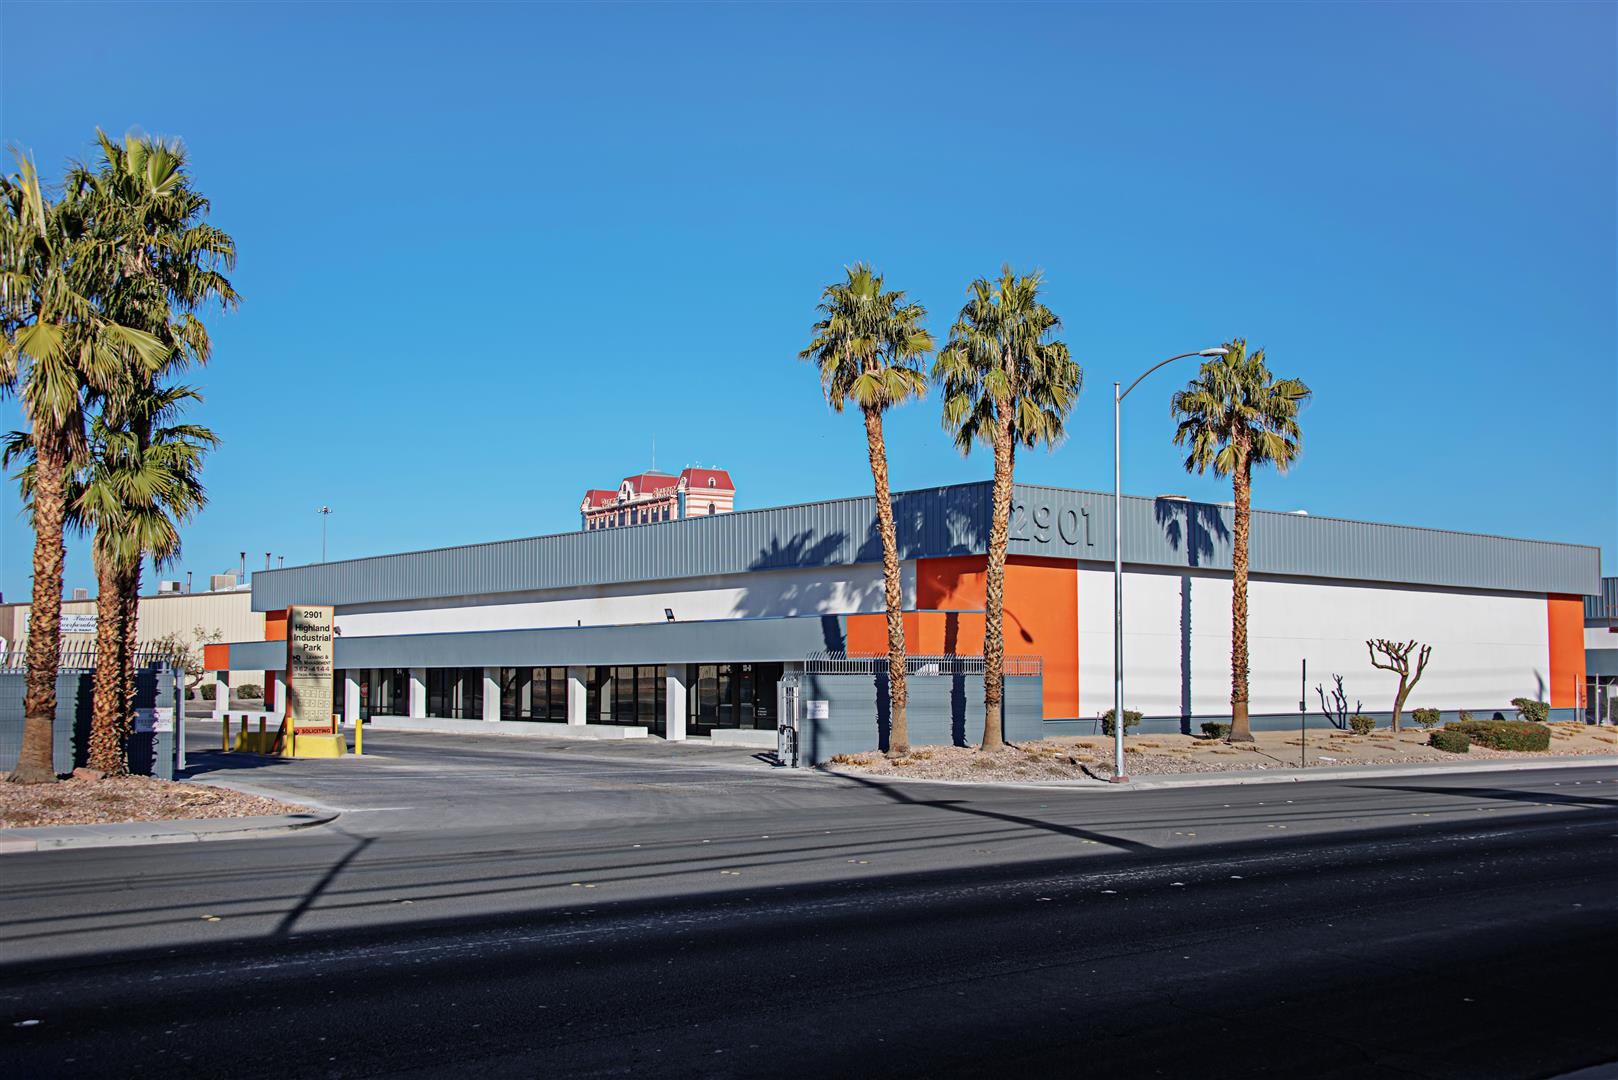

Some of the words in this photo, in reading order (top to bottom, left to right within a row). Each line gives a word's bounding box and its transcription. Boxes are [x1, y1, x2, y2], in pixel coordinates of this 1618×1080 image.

[1008, 503, 1094, 547] 2901
[304, 611, 322, 619] 2901
[295, 624, 330, 633] Highland
[294, 634, 331, 642] Industrial
